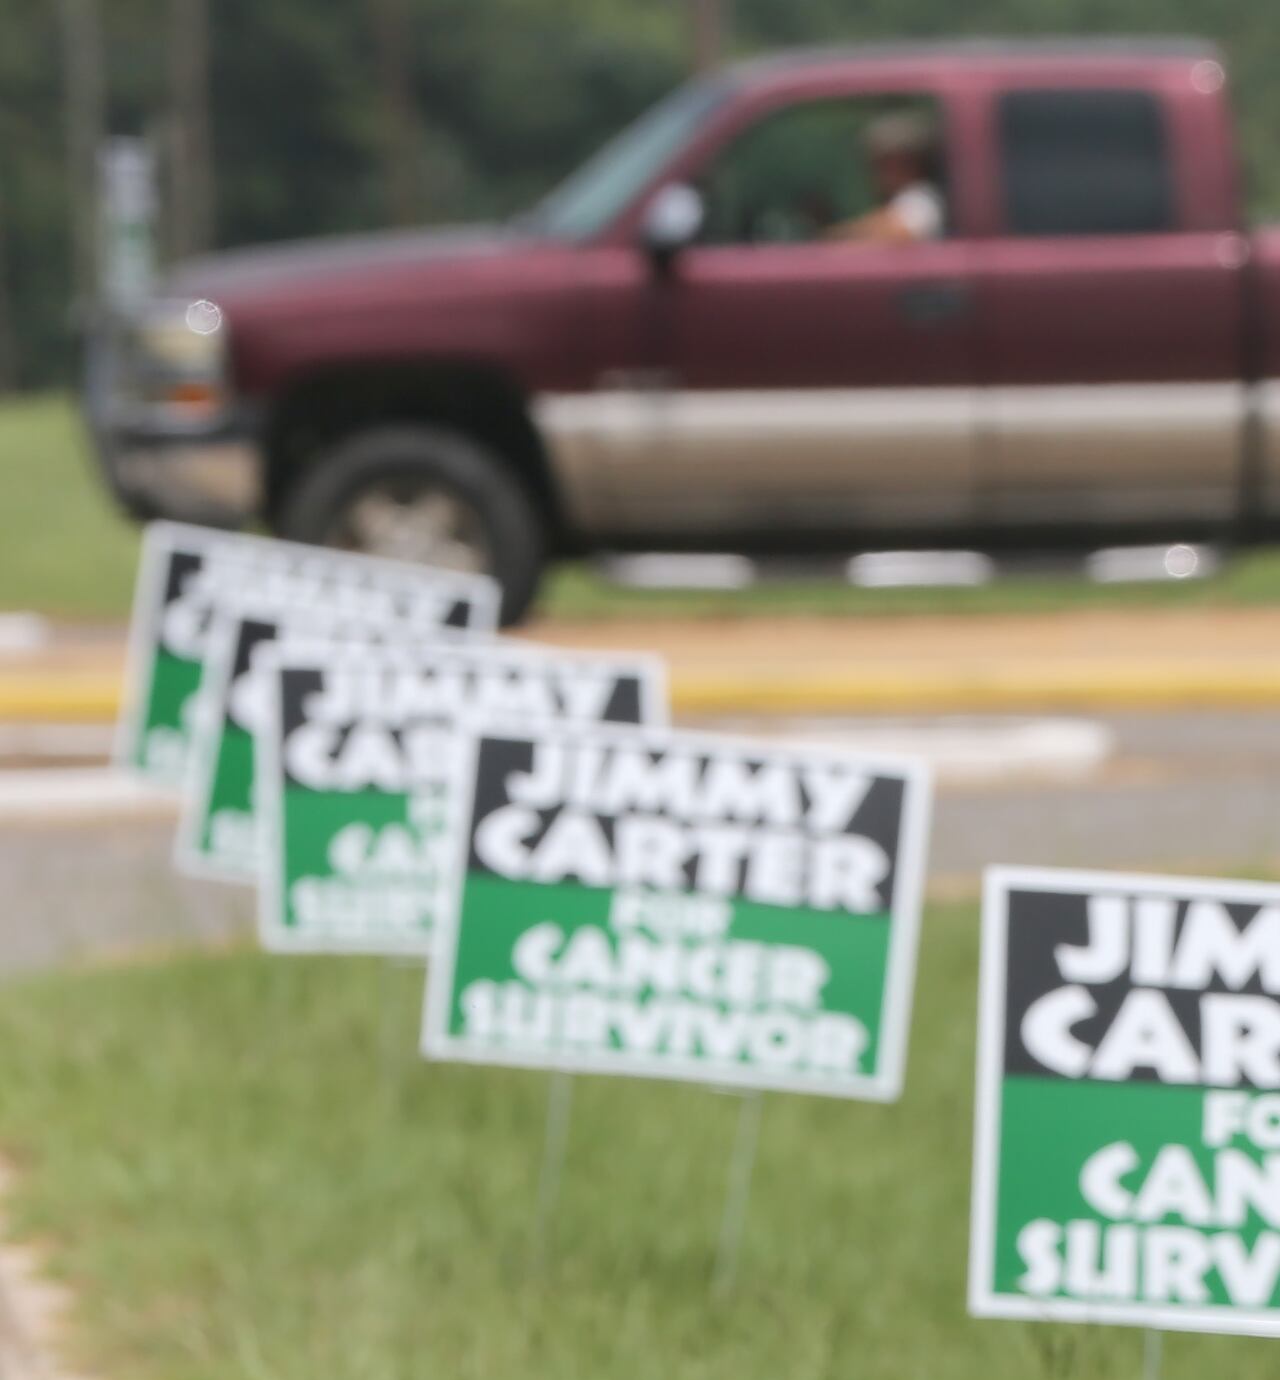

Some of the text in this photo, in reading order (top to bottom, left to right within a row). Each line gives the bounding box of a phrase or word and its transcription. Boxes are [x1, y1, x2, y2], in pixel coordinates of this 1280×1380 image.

[504, 740, 873, 832] JIMMY
[474, 803, 888, 913] CARTER
[511, 922, 830, 1008] CANCER
[461, 978, 867, 1073] SURVIVOR
